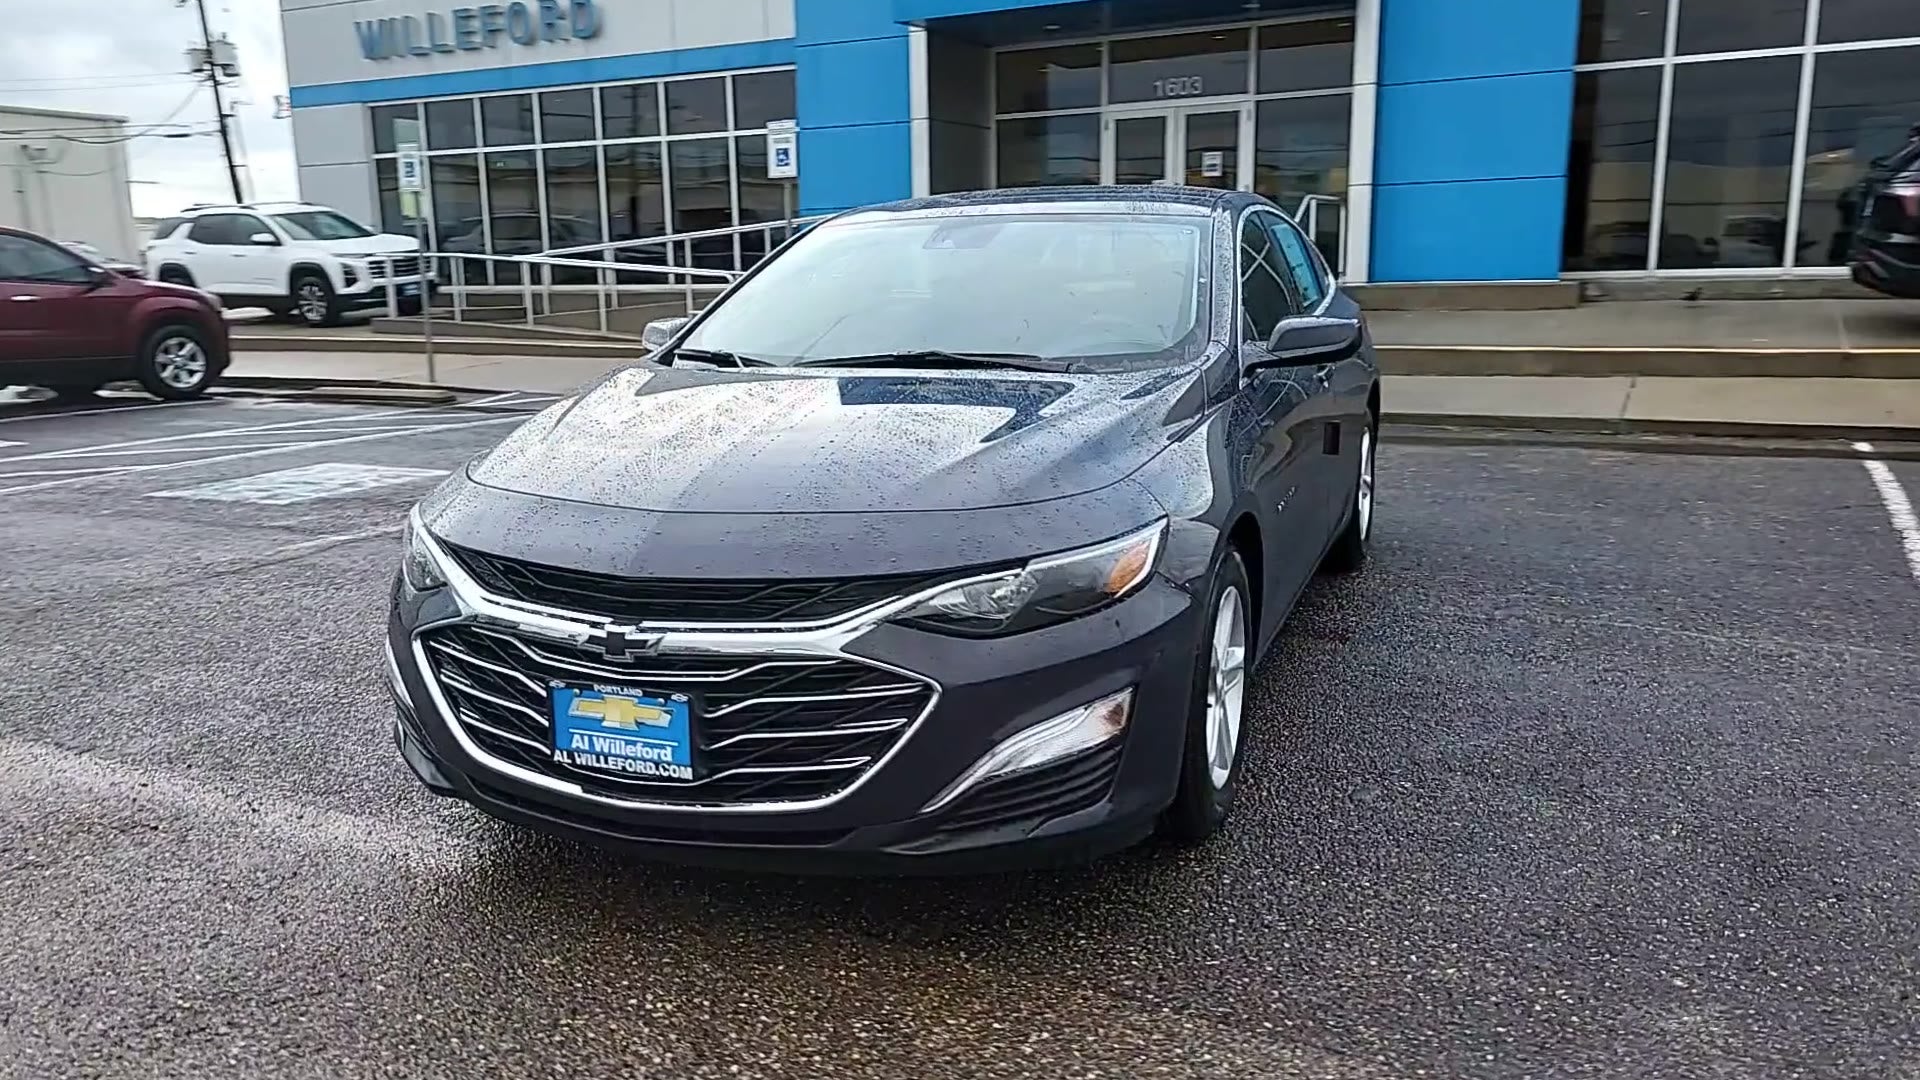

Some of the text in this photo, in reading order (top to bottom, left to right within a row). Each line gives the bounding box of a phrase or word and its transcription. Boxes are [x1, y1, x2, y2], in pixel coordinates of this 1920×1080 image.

[353, 0, 602, 60] WILLEFORD
[1153, 76, 1202, 97] 1603
[593, 684, 644, 697] PORTLAND
[571, 734, 673, 762] Al Willeford
[553, 749, 693, 780] AL WILLEFORD.COM
